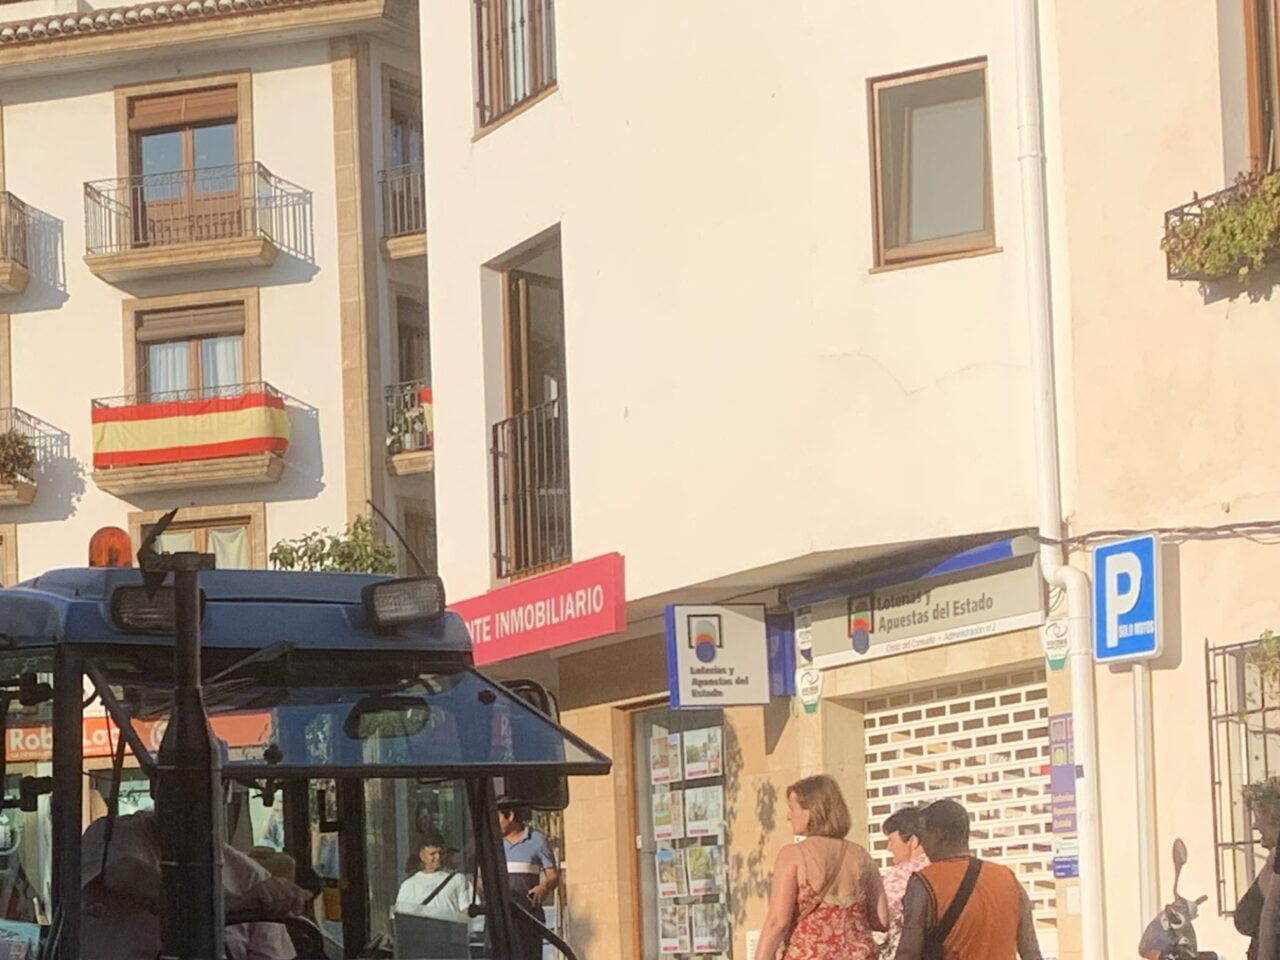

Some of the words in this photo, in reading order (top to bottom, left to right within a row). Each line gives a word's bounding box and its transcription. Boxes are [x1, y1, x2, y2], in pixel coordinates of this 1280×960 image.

[495, 585, 604, 640] INMOBILIARIO
[878, 608, 930, 634] Apuestas
[932, 603, 950, 620] del
[953, 592, 994, 616] Estado
